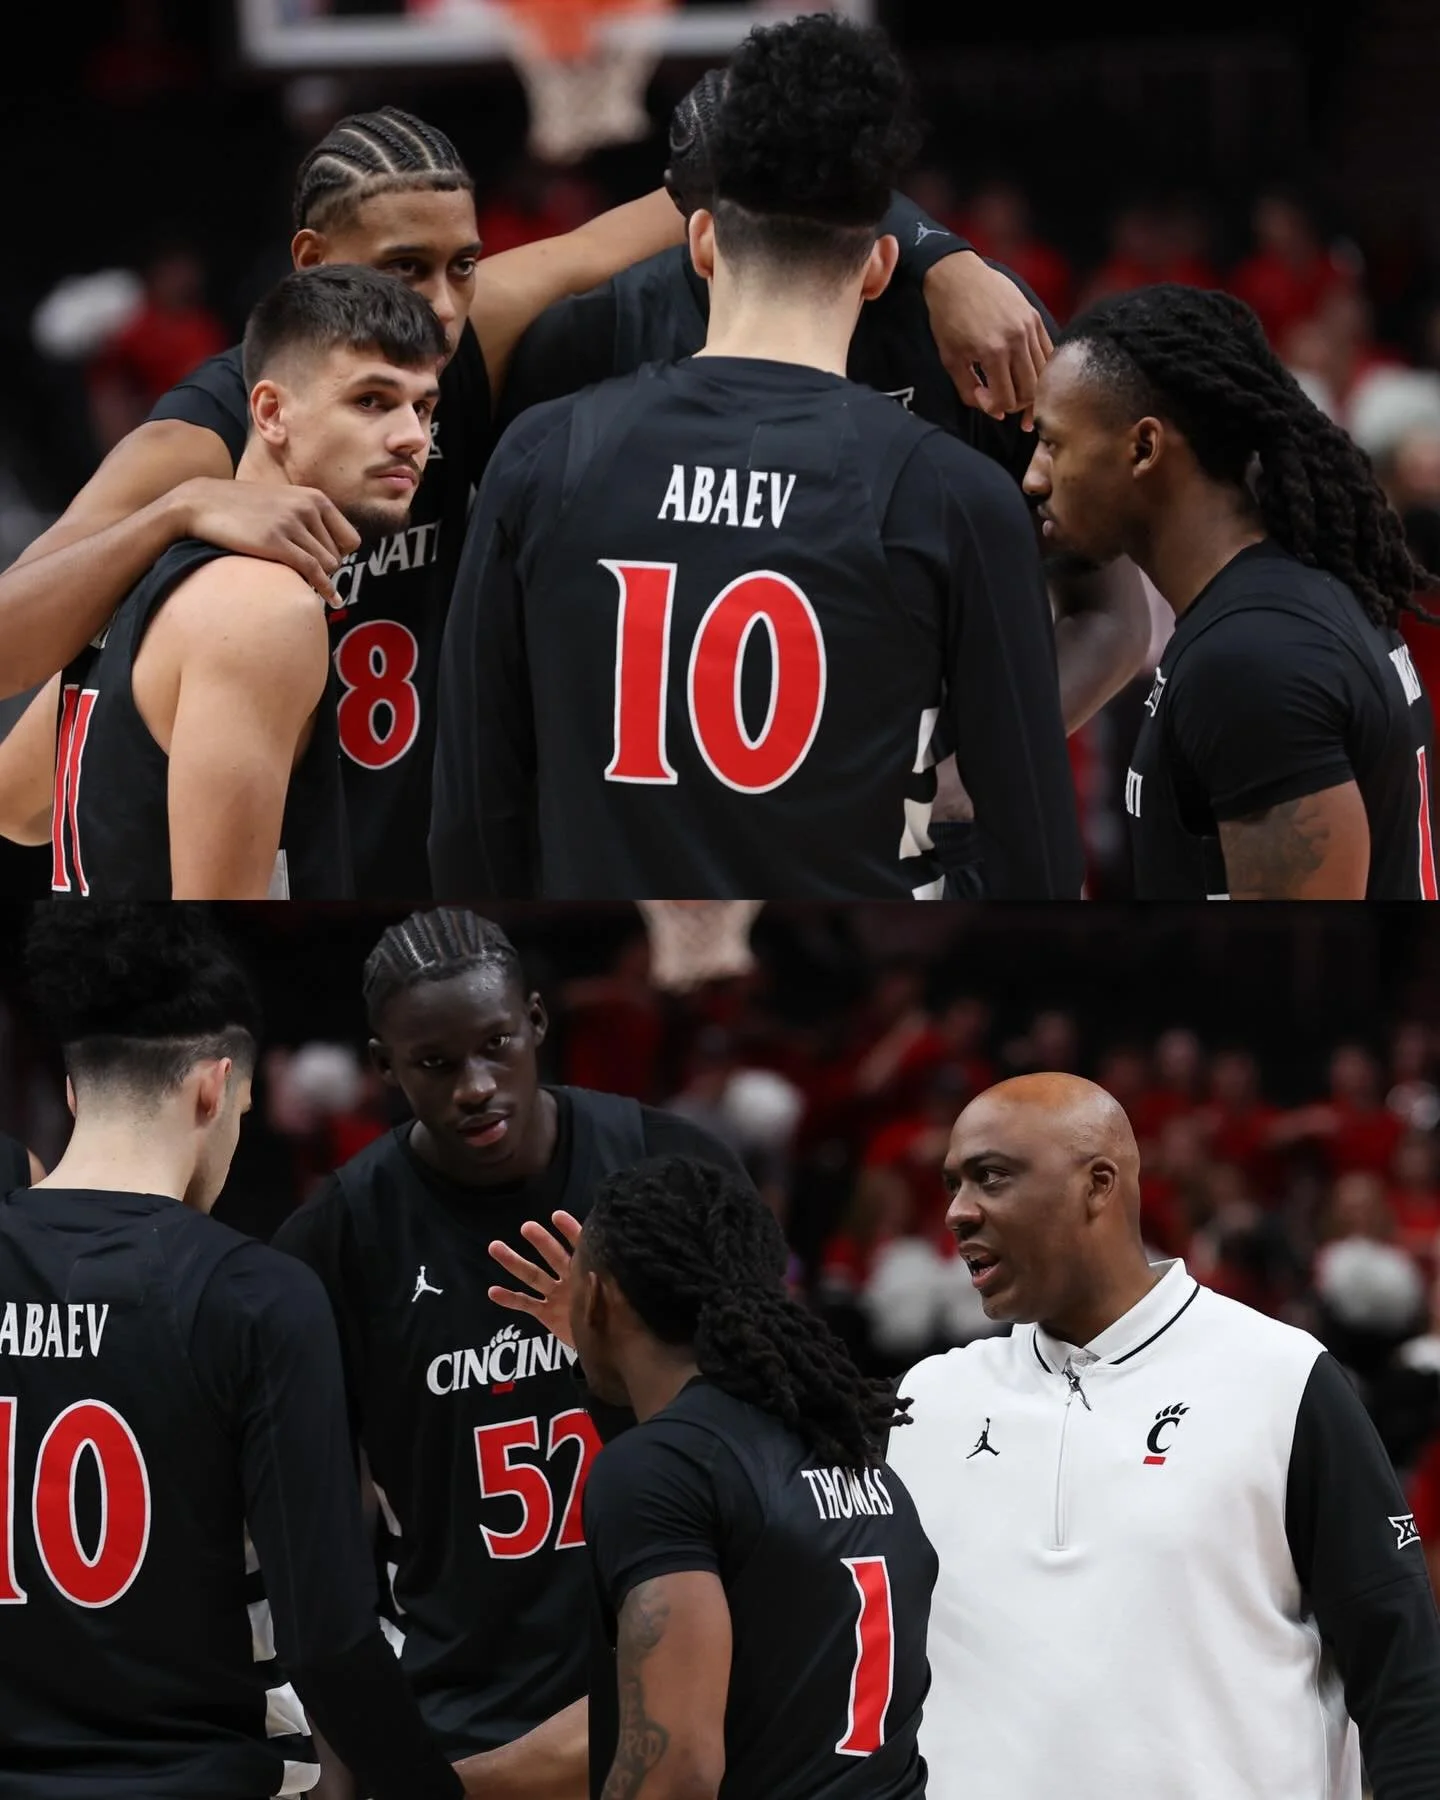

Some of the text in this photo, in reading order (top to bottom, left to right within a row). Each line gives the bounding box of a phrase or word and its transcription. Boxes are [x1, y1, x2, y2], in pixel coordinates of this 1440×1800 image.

[657, 464, 796, 528] ABAEV
[333, 619, 420, 770] 8
[597, 559, 827, 794] 10
[51, 684, 99, 896] 11
[0, 1302, 109, 1357] ABAEV
[473, 1408, 604, 1560] 52
[800, 1465, 894, 1520] THOMAS
[835, 1555, 895, 1757] 1
